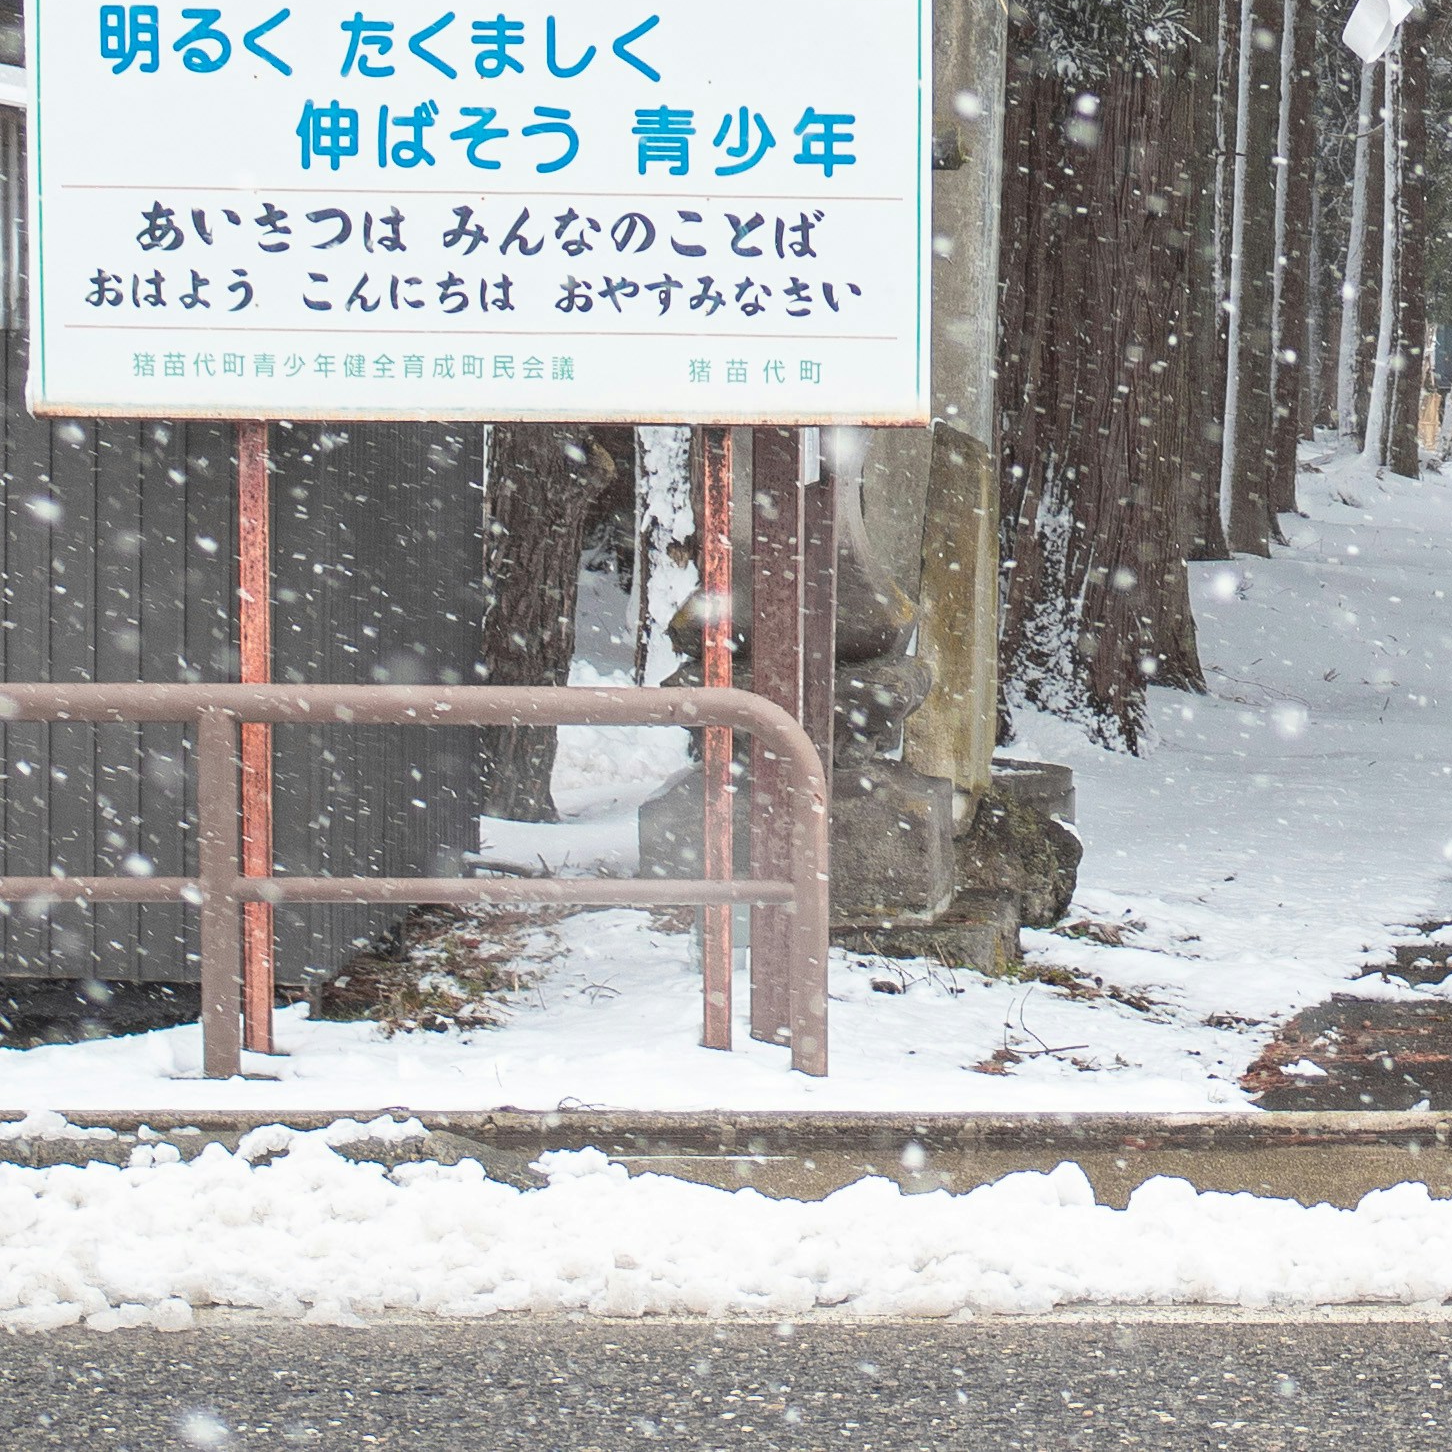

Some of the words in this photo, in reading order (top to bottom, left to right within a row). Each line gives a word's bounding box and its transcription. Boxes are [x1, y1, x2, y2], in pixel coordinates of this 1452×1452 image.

[99, 4, 292, 76] 明るく
[340, 11, 662, 82] たくましく
[296, 99, 581, 174] 伸ばそう
[631, 105, 857, 178] 青少年
[136, 201, 407, 253] あいさつは
[443, 206, 825, 259] みんなのことば
[86, 268, 253, 312] おはよう
[303, 272, 516, 314] こんにちは
[555, 274, 863, 317] おやすみなさい
[132, 352, 575, 381] 猪苗代町青少年健全育成町民会議
[688, 358, 822, 384] 猪苗代町
